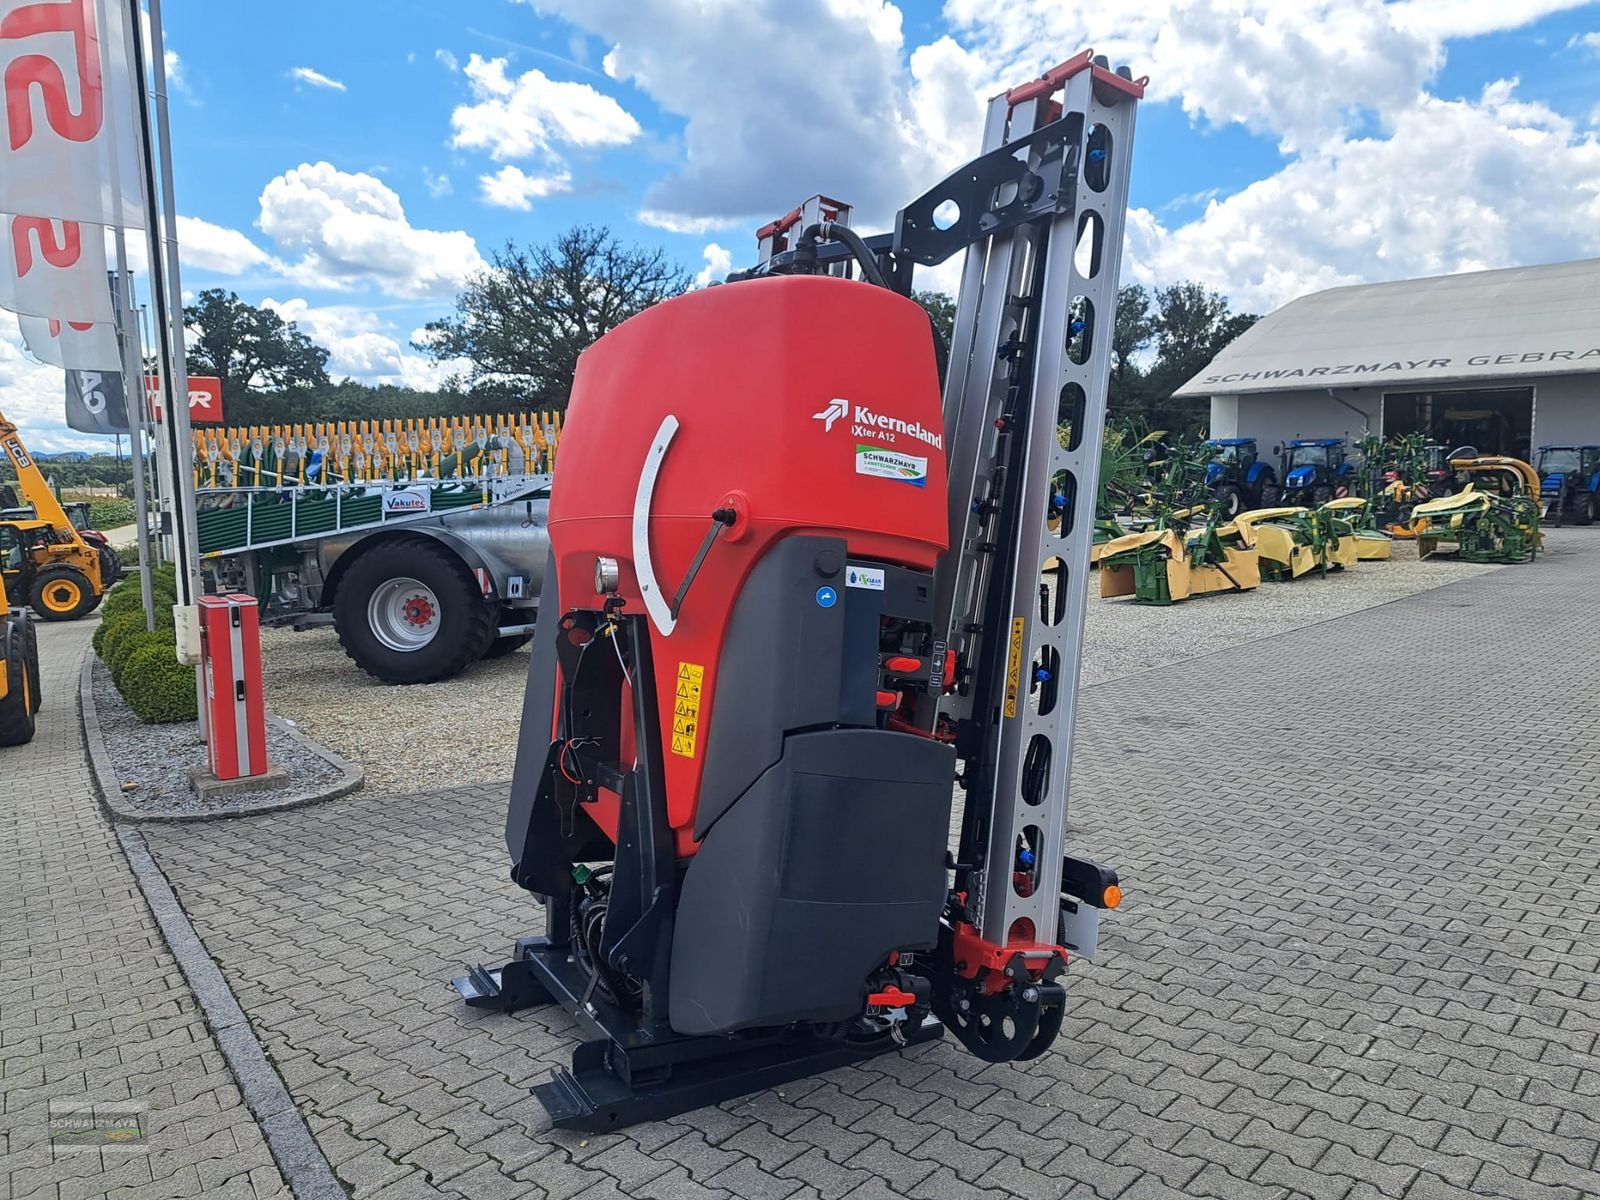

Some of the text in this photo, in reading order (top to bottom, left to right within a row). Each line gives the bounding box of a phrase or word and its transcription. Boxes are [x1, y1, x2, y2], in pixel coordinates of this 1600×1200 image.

[1204, 359, 1451, 384] SCHWARZMAYR
[852, 425, 895, 442] iXter A12
[855, 406, 942, 449] Kverneland
[6, 439, 31, 468] JCB
[863, 452, 916, 470] SCHWARZMAYR
[387, 498, 425, 509] Vakutec
